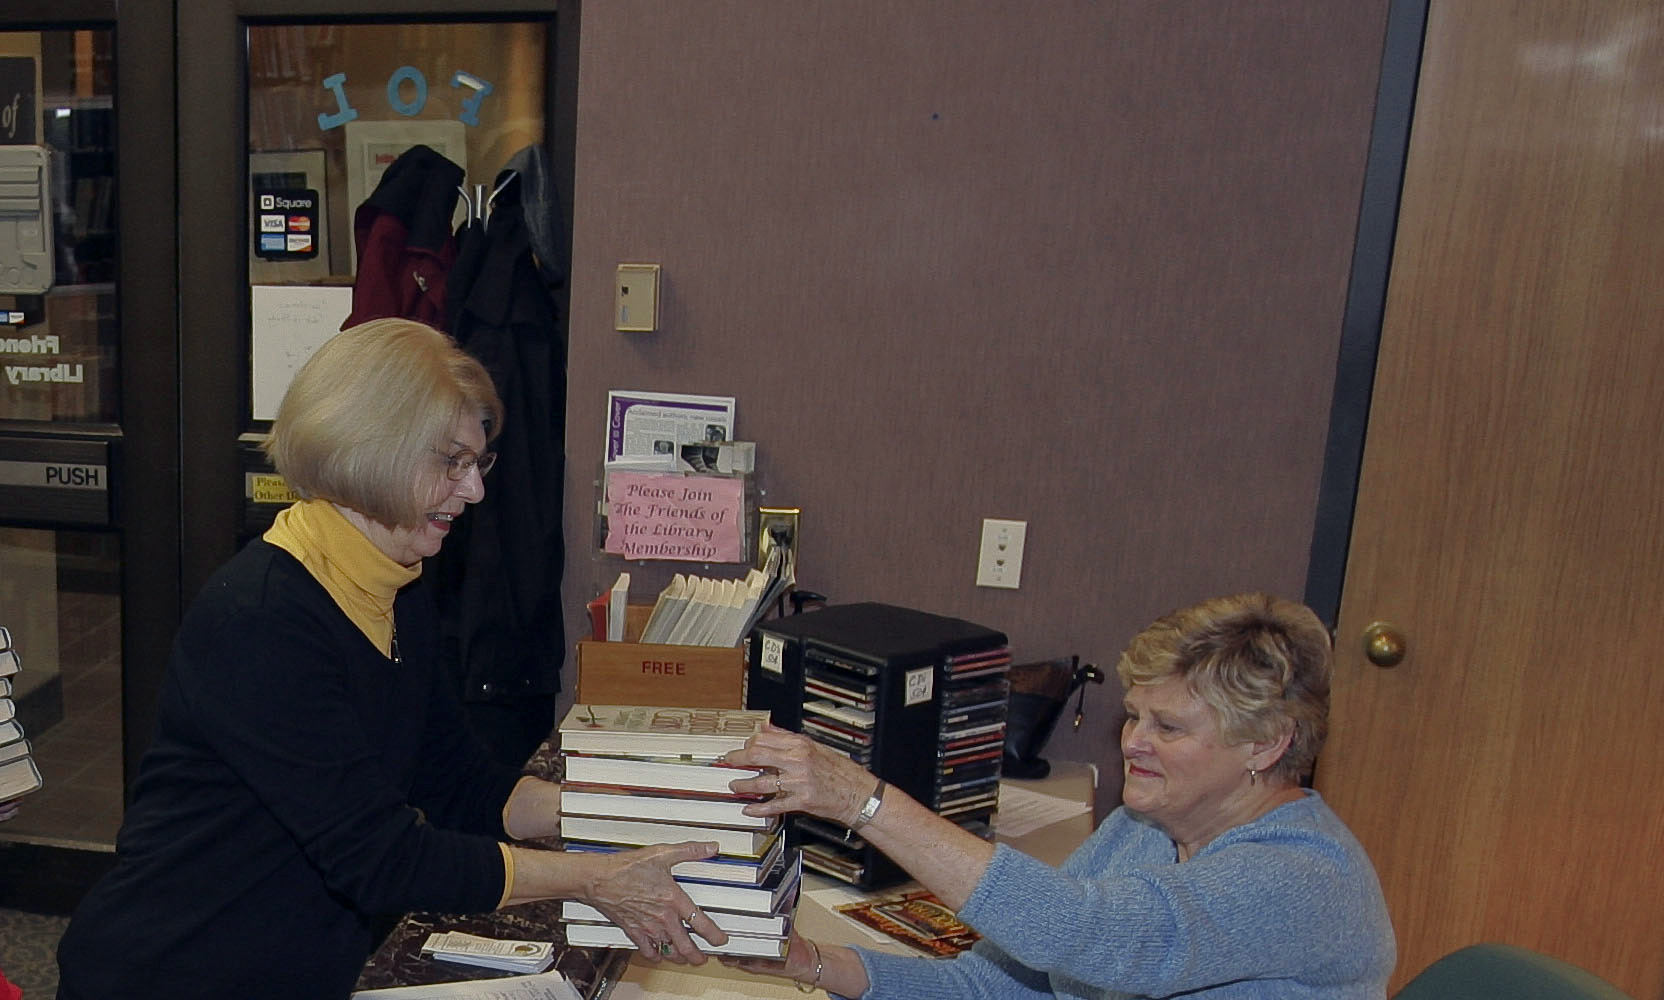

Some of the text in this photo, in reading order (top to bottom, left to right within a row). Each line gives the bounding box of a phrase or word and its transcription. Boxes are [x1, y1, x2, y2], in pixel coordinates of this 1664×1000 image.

[2, 94, 21, 138] of
[276, 197, 312, 210] Square
[264, 219, 284, 229] VISA
[45, 466, 99, 486] PUSH
[627, 483, 713, 501] Please Join
[614, 501, 729, 525] The Friends of
[624, 523, 714, 541] the Library
[621, 537, 717, 558] Membership
[641, 661, 686, 676] FREE
